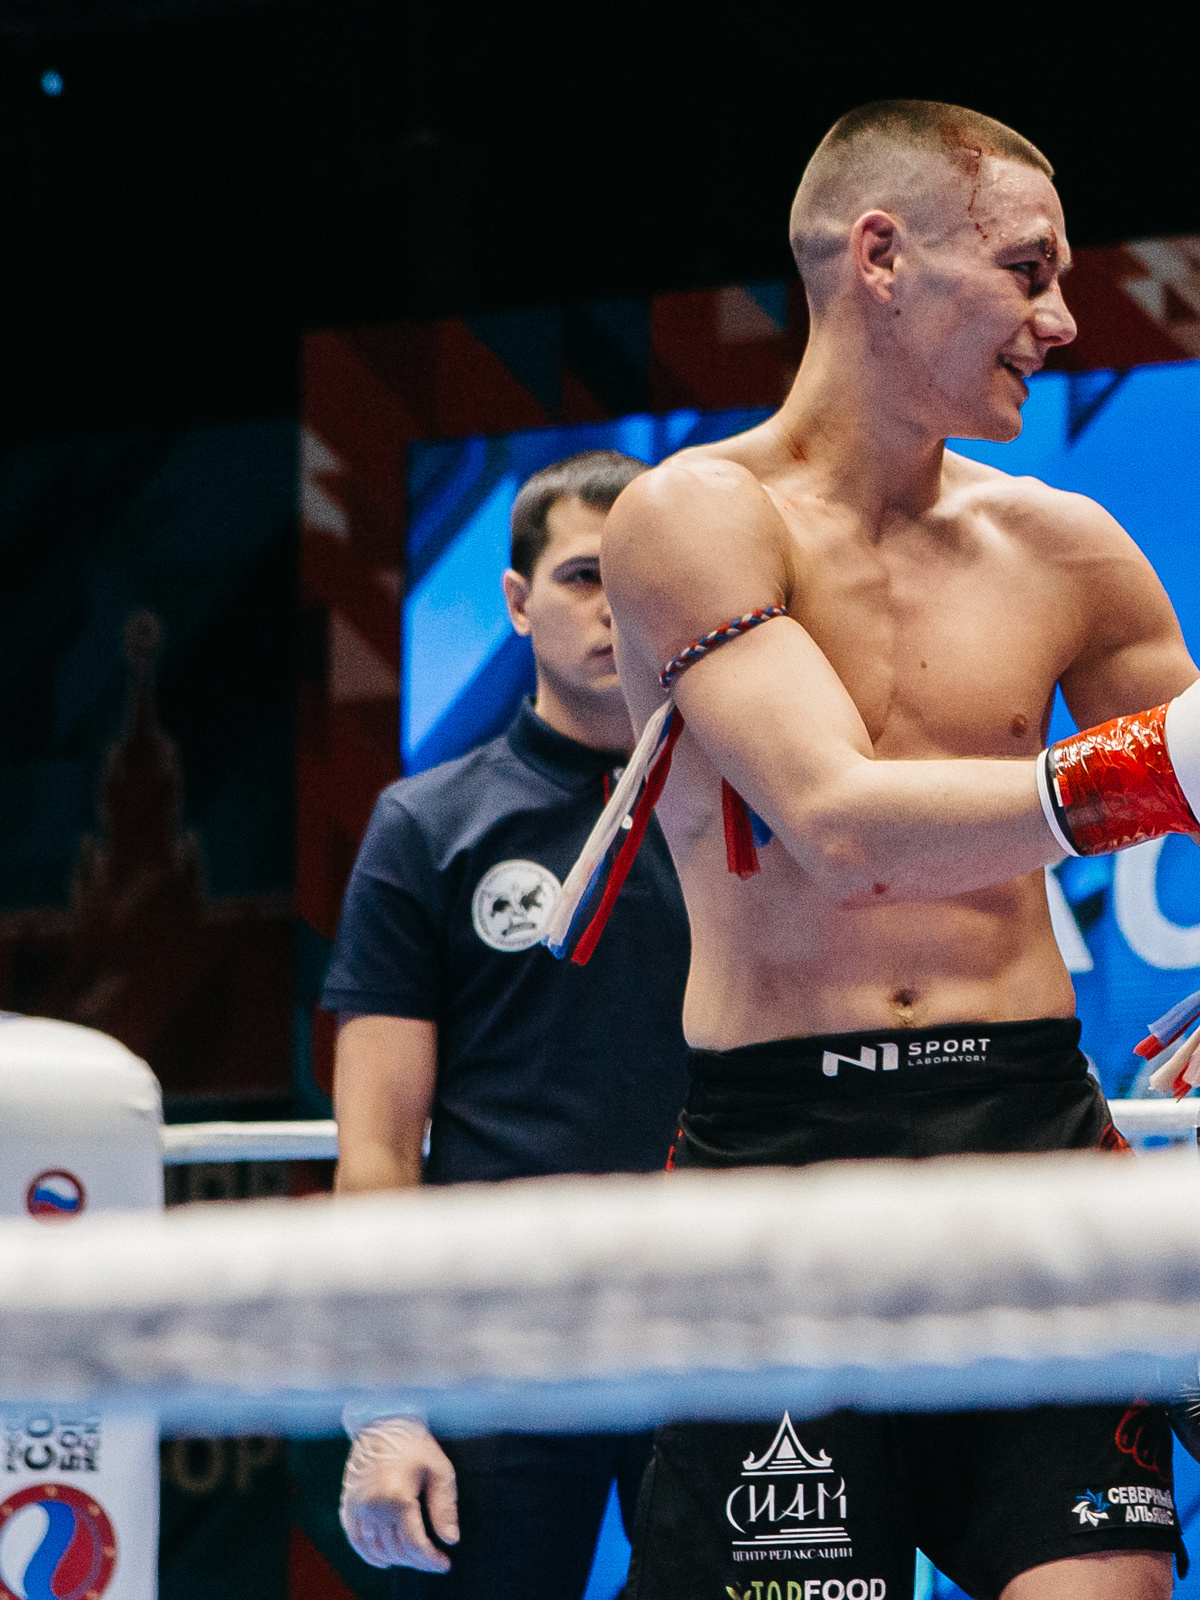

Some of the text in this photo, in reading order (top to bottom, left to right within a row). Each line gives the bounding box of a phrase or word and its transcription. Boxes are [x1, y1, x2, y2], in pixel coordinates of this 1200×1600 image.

[908, 1038, 991, 1056] SPORT
[907, 1055, 987, 1067] LABORATORY
[732, 1547, 853, 1562] ЦЕНТР РЕЛАКСАЦИИ
